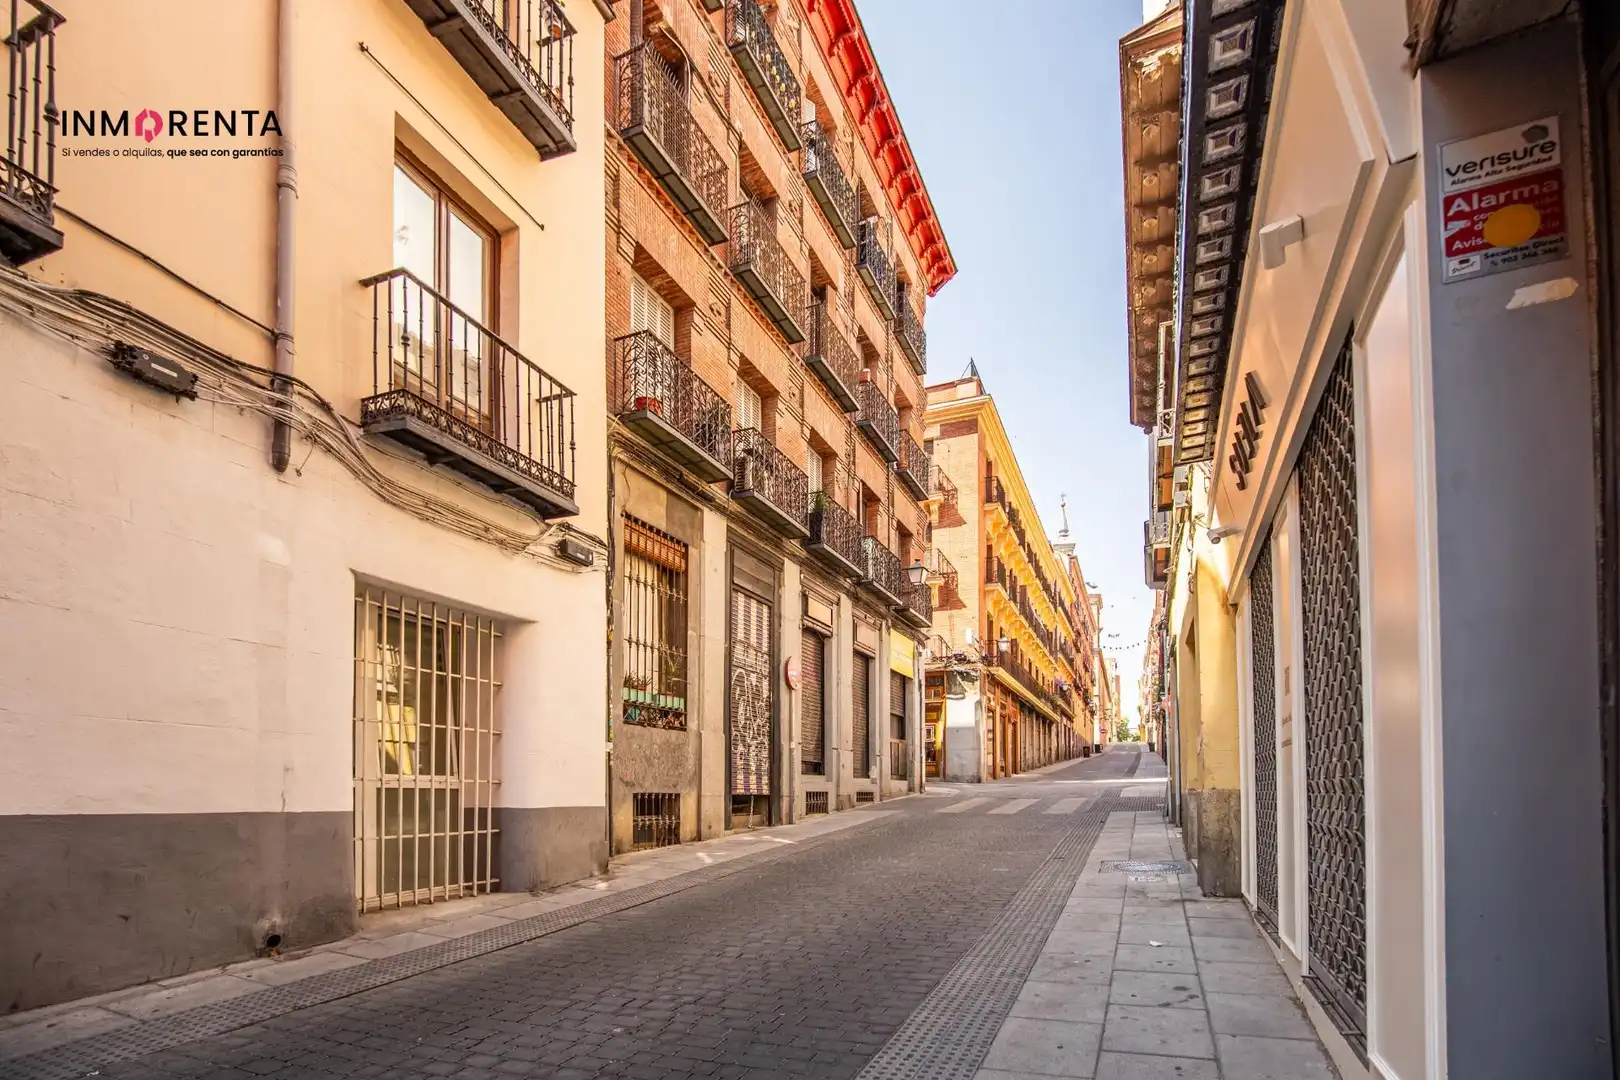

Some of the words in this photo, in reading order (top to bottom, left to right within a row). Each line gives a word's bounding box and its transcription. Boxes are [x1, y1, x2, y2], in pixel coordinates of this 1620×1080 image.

[1446, 140, 1556, 177] verisure
[1447, 179, 1560, 216] Alarma
[1452, 236, 1488, 251] Avis
